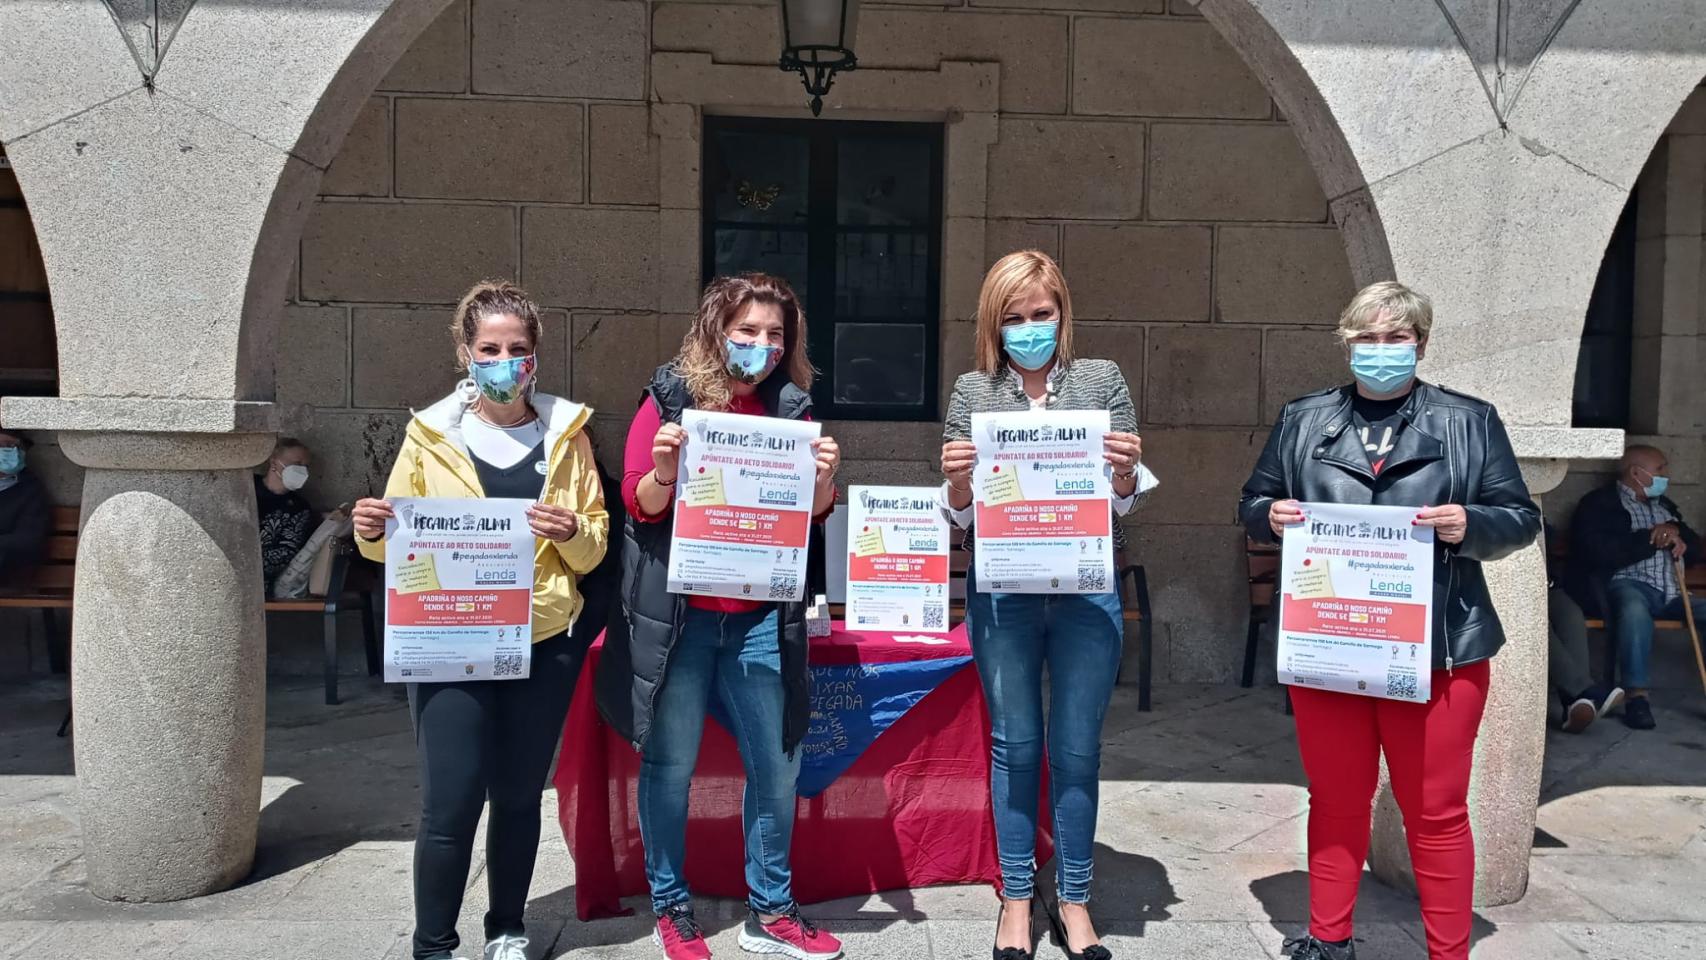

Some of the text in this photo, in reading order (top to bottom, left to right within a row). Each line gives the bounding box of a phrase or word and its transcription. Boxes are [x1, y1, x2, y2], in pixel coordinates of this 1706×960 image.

[707, 431, 748, 447] PEGADAS
[764, 437, 795, 451] ALMA
[997, 429, 1039, 443] PEGADAS
[1054, 428, 1086, 442] ALMA
[1036, 452, 1053, 460] RETO
[1053, 451, 1088, 459] SOLIDARIO!
[734, 457, 743, 465] AO
[744, 458, 760, 467] RETO
[762, 460, 794, 470] SOLIDARIO!
[1055, 478, 1094, 490] Lenda
[759, 487, 797, 500] Lenda
[1004, 505, 1033, 513] APADRIÑA
[1039, 505, 1055, 513] NOSO
[1055, 504, 1078, 512] CAMIÑO
[704, 509, 734, 518] APADRIÑA
[757, 513, 779, 521] CAMIÑO
[1009, 514, 1029, 522] DENDE
[414, 516, 460, 531] PEGADAS
[476, 518, 511, 531] ALMA
[709, 518, 729, 526] DENDE
[763, 522, 773, 530] KM
[1311, 522, 1356, 538] PEGADAS
[1372, 526, 1407, 540] ALMA
[456, 542, 474, 550] RETO
[475, 542, 512, 550] SOLIDARIO!
[1341, 548, 1351, 556] AO
[1352, 549, 1369, 557] RETO
[1370, 551, 1407, 560] SOLIDARIO!
[475, 569, 517, 580] Lenda
[1370, 578, 1412, 592] Lenda
[418, 594, 450, 602] APADRIÑA
[474, 594, 498, 602] CAMIÑO
[423, 603, 445, 611] DENDE
[1312, 602, 1344, 611] APADRIÑA
[1350, 605, 1367, 614] NOSO
[1368, 606, 1392, 615] CAMIÑO
[1317, 611, 1338, 620] DENDE
[1376, 616, 1387, 624] KM
